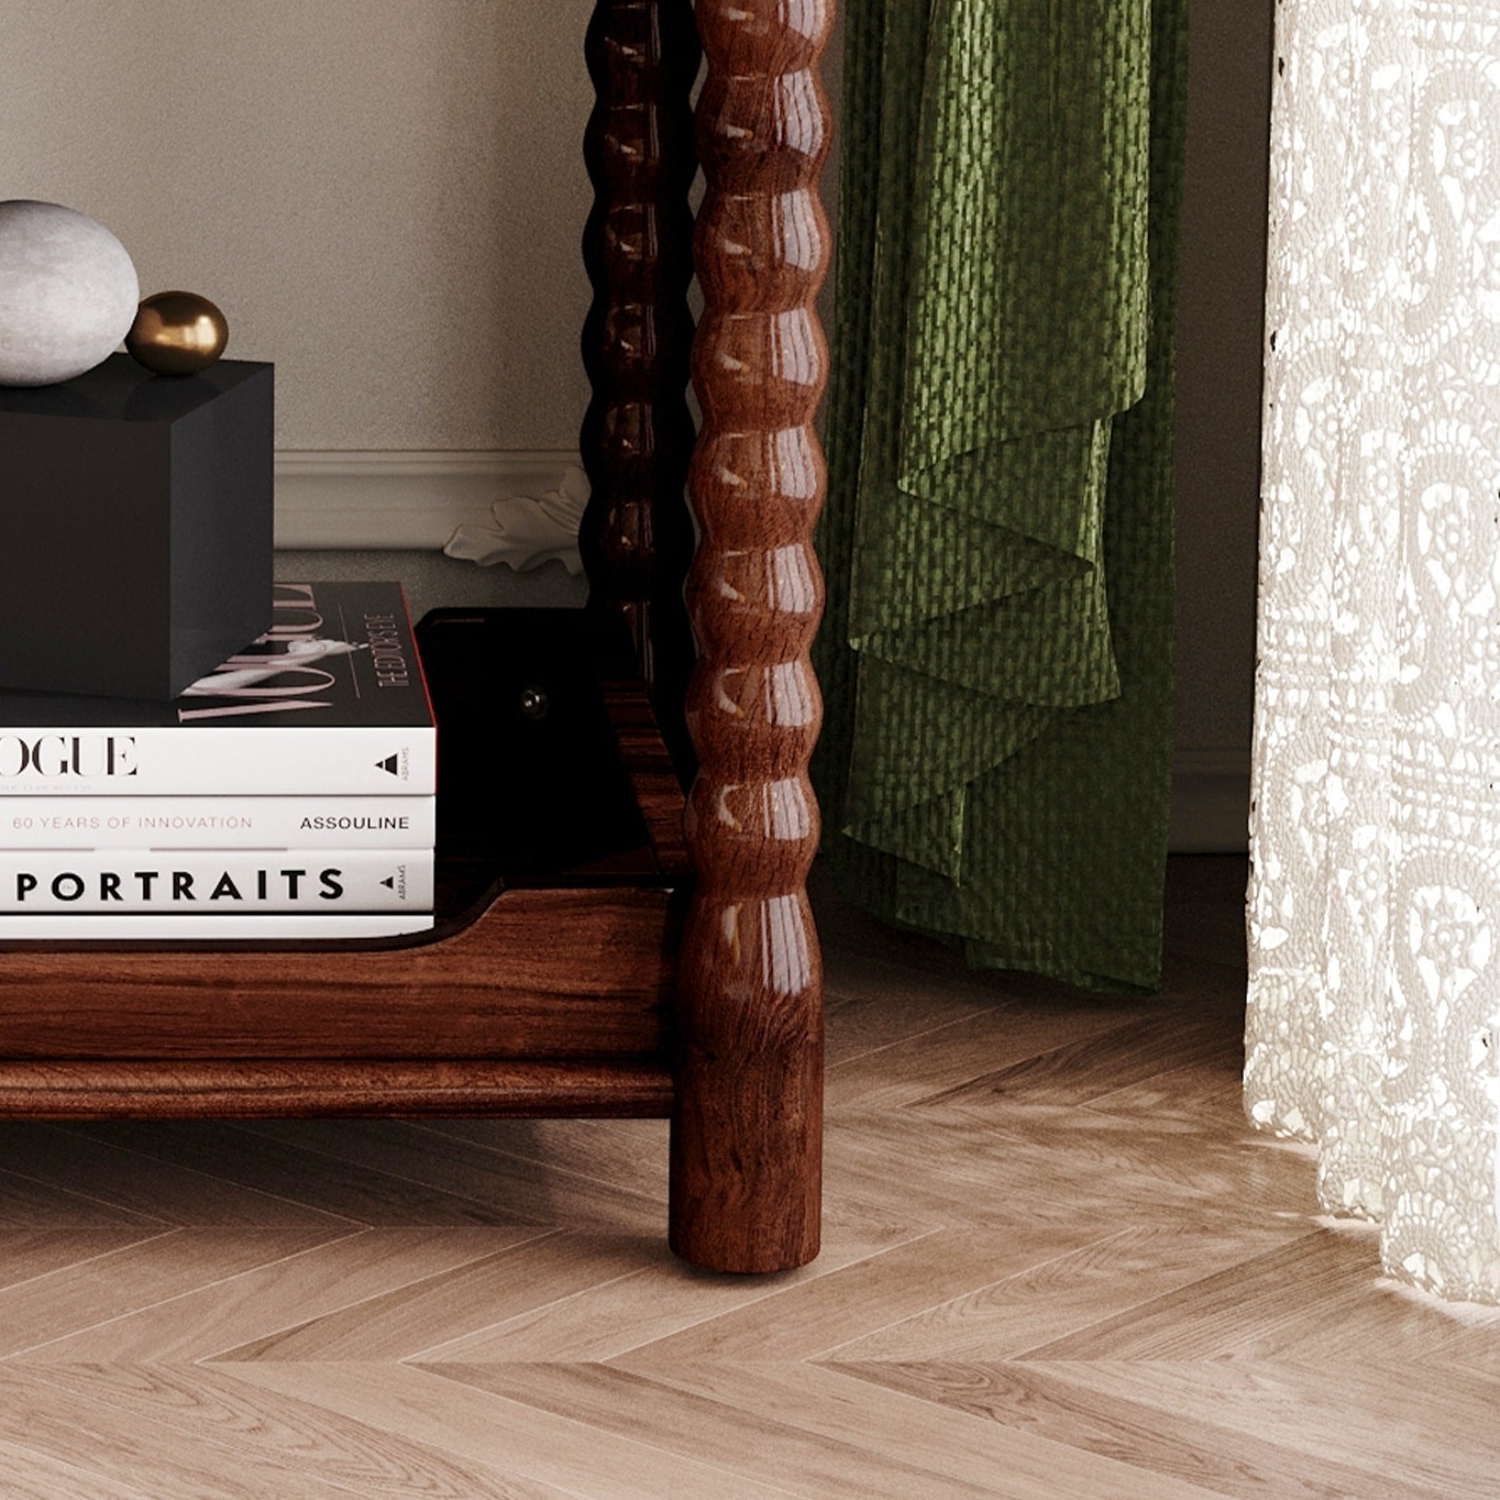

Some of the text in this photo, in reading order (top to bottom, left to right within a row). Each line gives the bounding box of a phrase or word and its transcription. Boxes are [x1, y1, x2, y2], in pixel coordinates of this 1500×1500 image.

[12, 816, 253, 830] 60 YEARS OF INNOVATION
[299, 815, 410, 830] ASSOULINE
[16, 868, 344, 902] PORTRAITS
